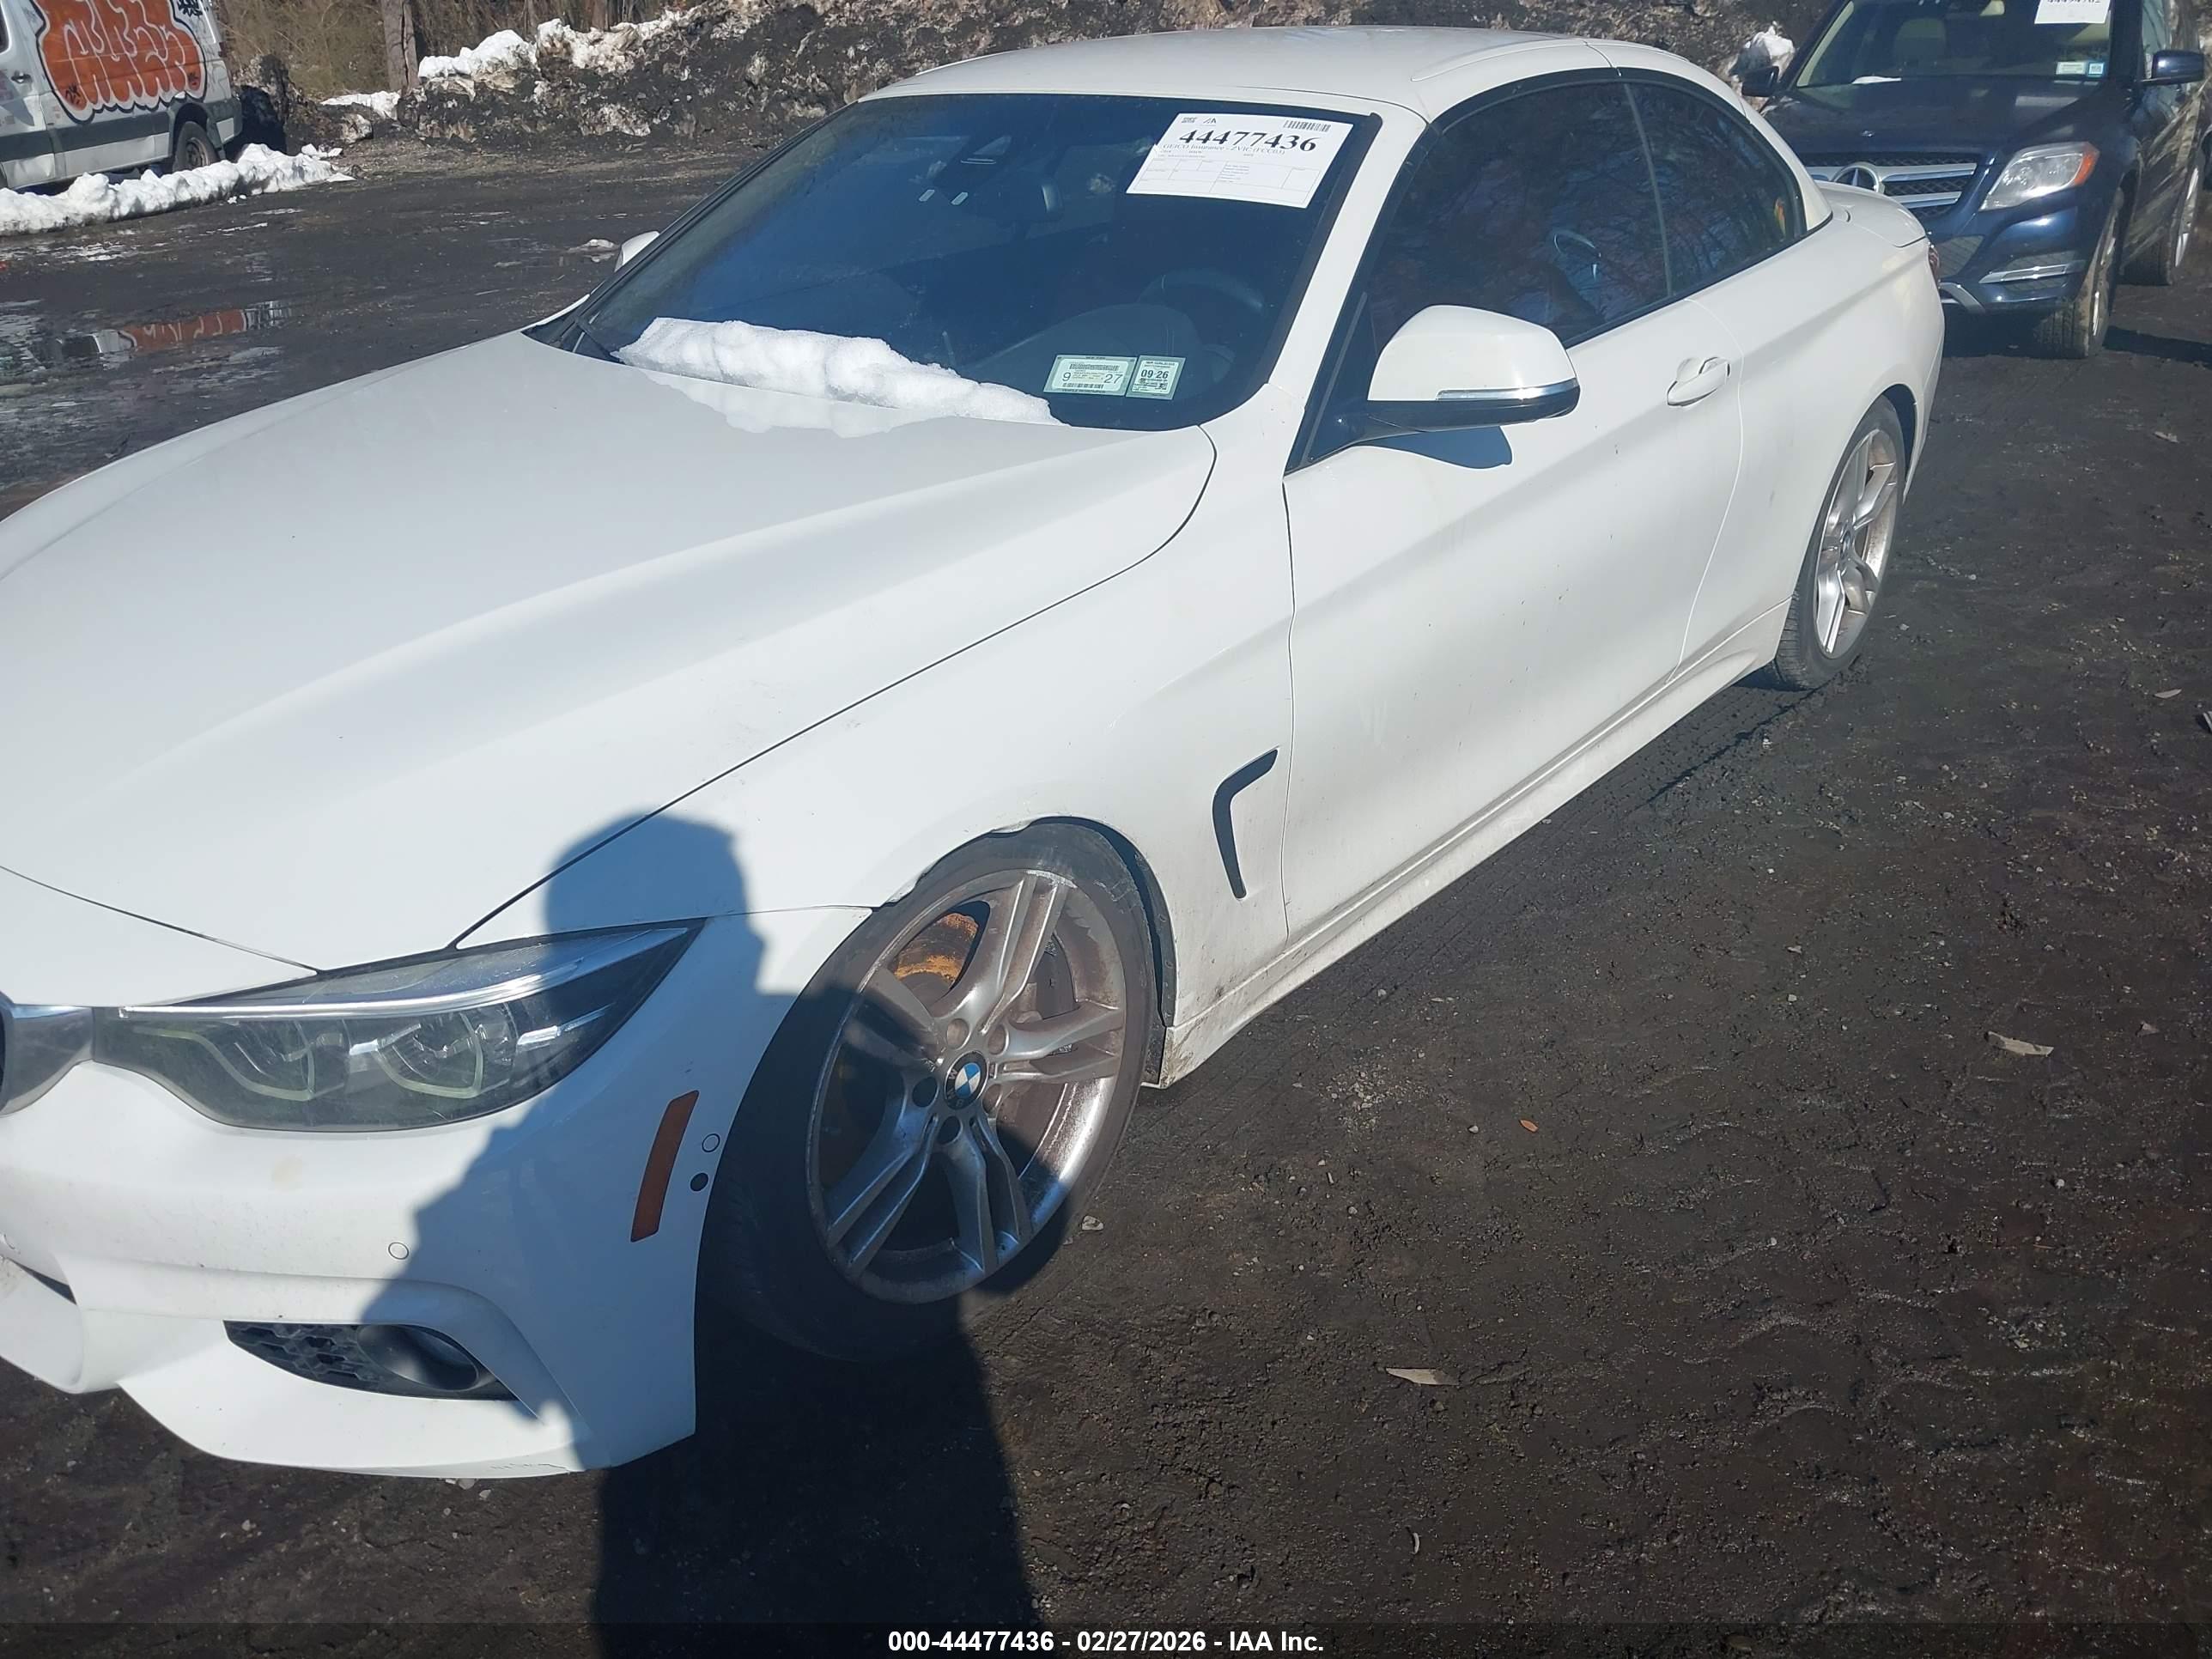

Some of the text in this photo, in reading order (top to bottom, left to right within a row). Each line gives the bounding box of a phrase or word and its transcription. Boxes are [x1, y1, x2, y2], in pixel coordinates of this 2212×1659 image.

[1179, 130, 1321, 152] 44477436
[1062, 372, 1072, 382] 9
[1103, 374, 1123, 384] 27
